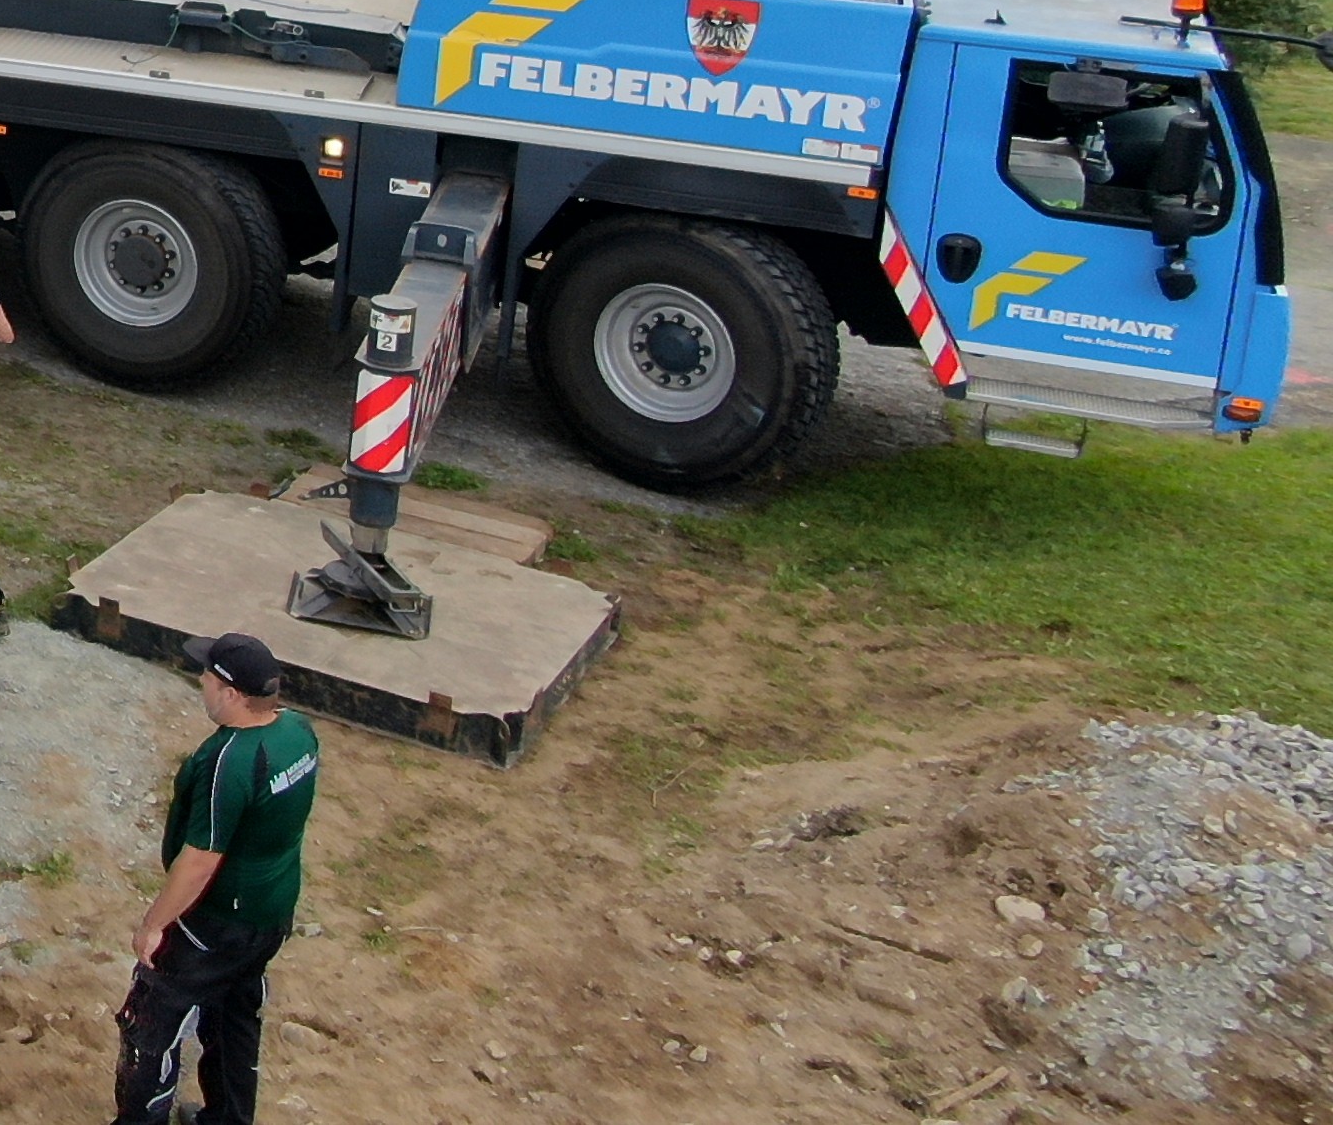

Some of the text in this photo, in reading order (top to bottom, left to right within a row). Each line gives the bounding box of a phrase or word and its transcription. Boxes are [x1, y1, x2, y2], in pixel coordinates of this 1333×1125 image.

[478, 52, 866, 133] FELBERMAYR
[1005, 302, 1174, 341] FELBERMAYR
[380, 334, 393, 350] 2
